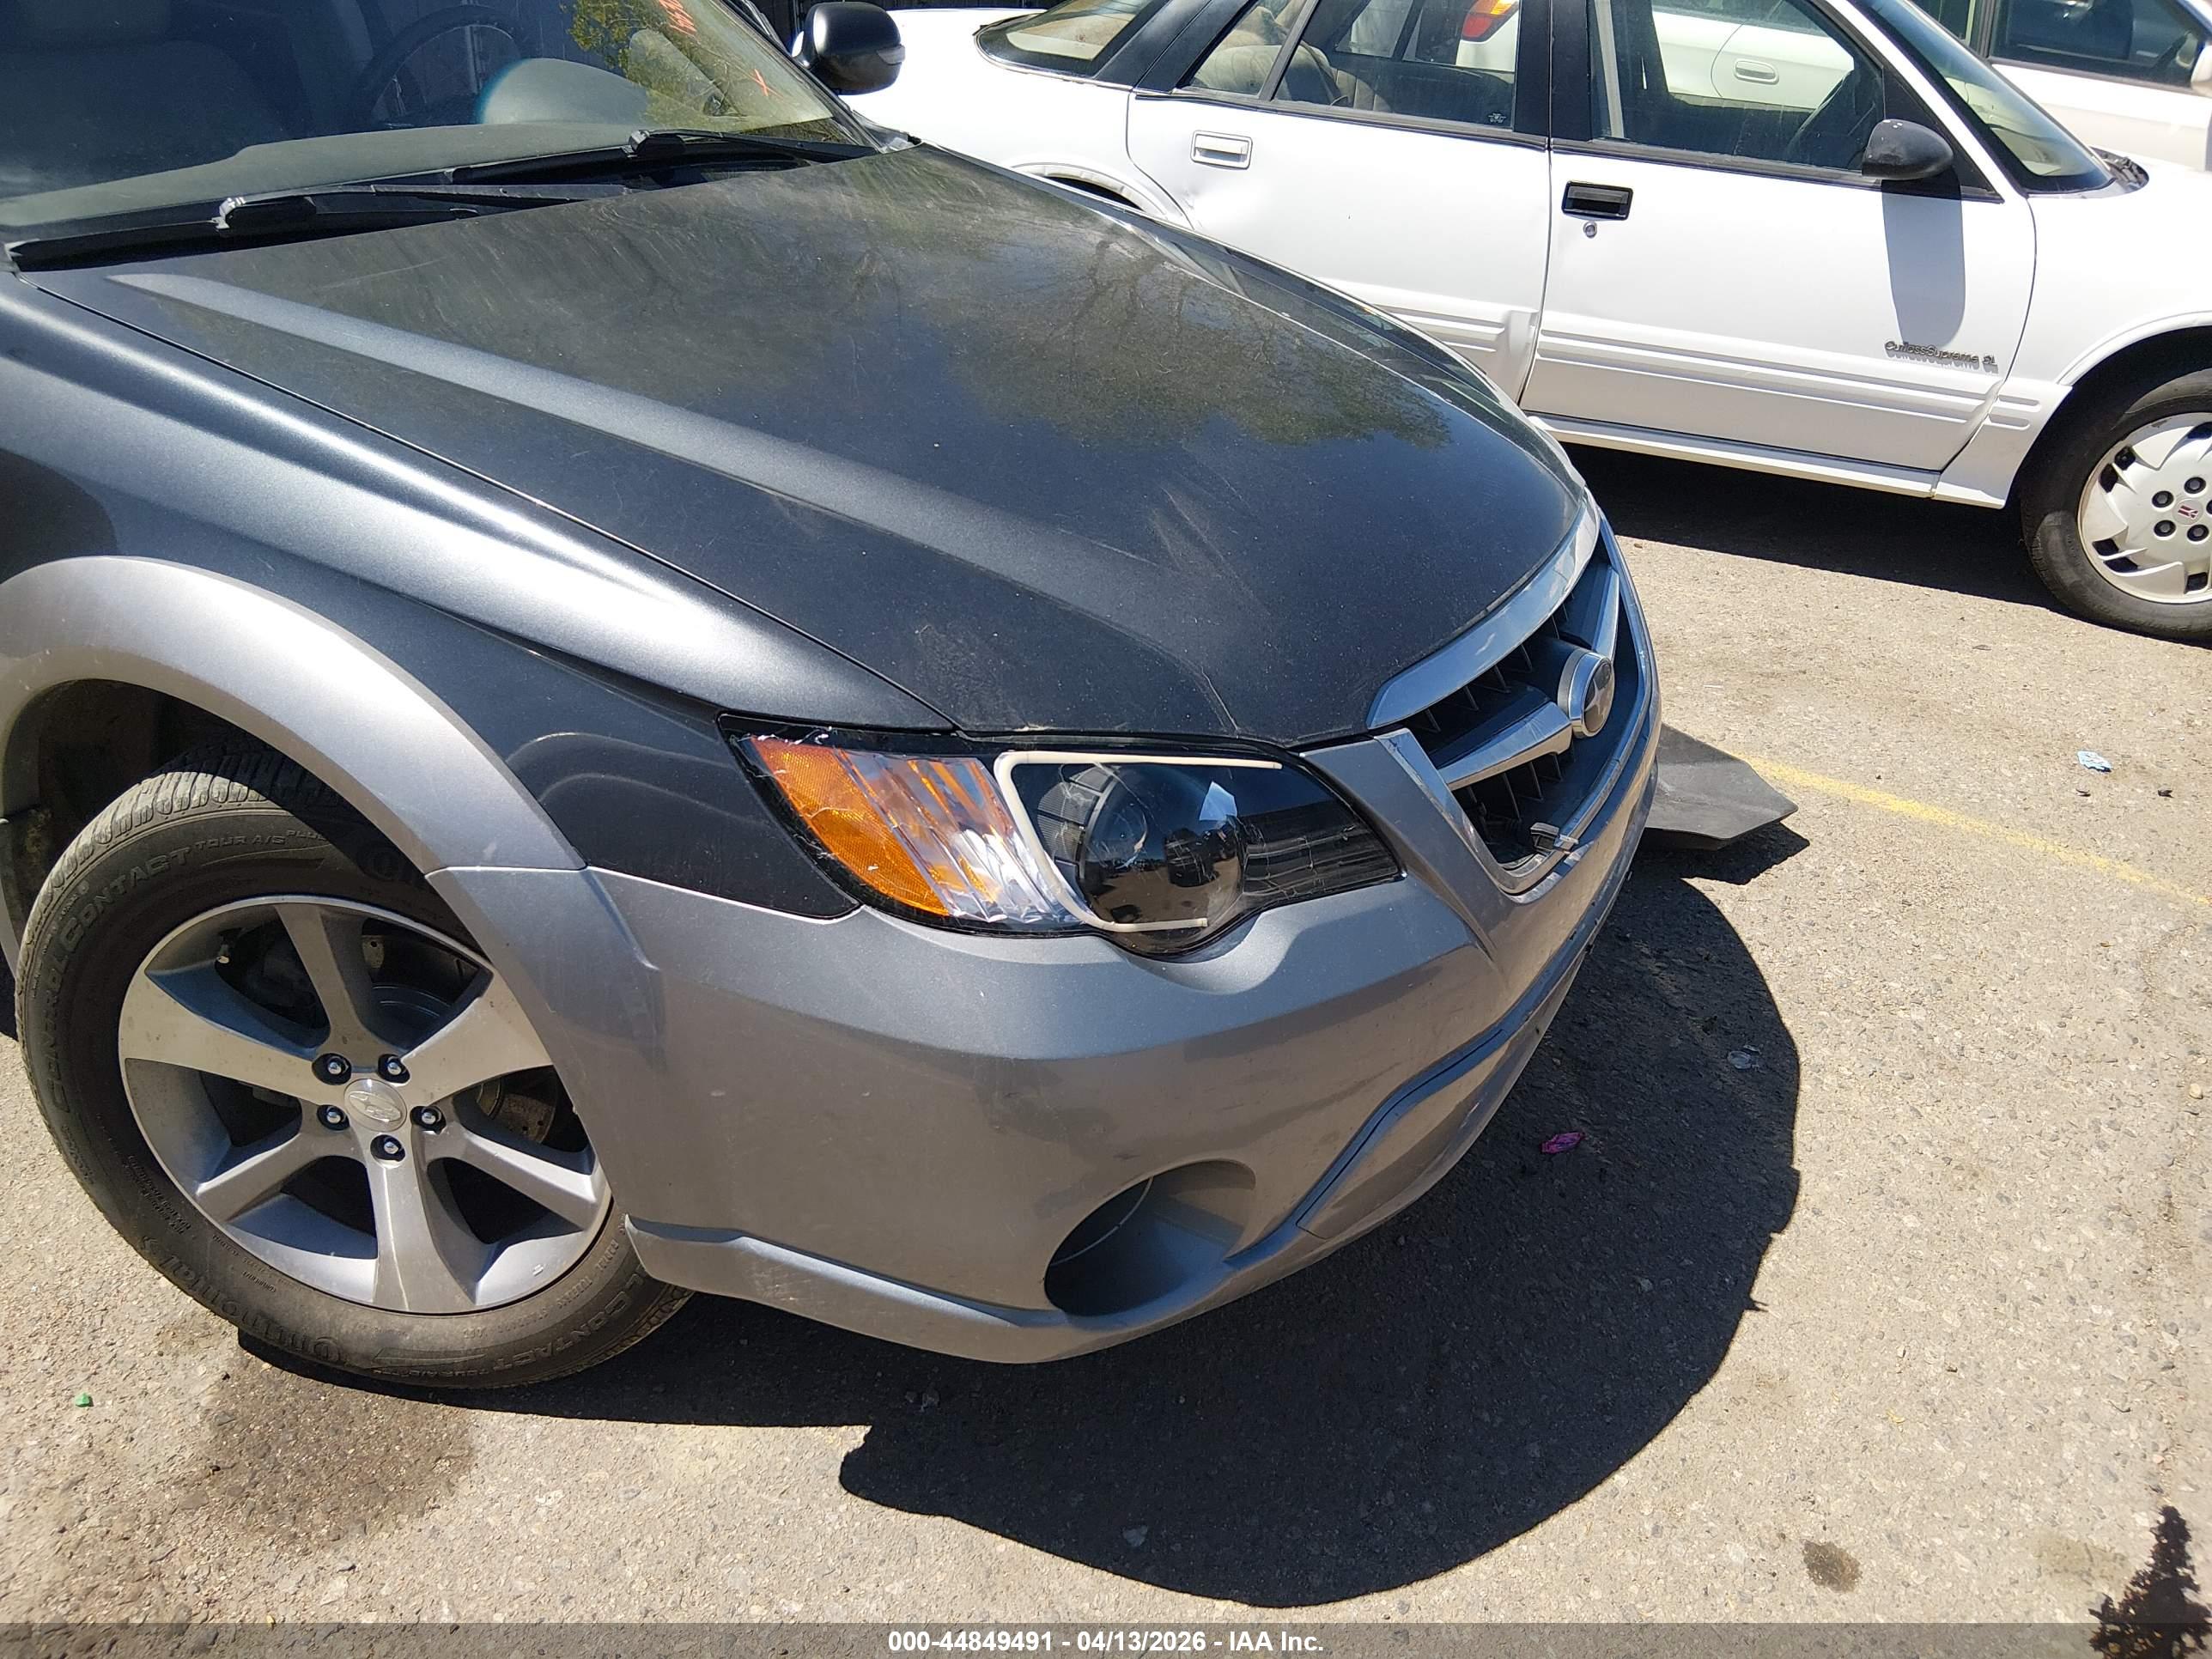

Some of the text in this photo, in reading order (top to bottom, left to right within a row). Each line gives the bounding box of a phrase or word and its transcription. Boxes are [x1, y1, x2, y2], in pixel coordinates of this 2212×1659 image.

[59, 847, 190, 953] CONTACT
[194, 835, 247, 851] TOUR
[252, 835, 287, 846] A/S
[493, 1291, 631, 1371] CONTACT
